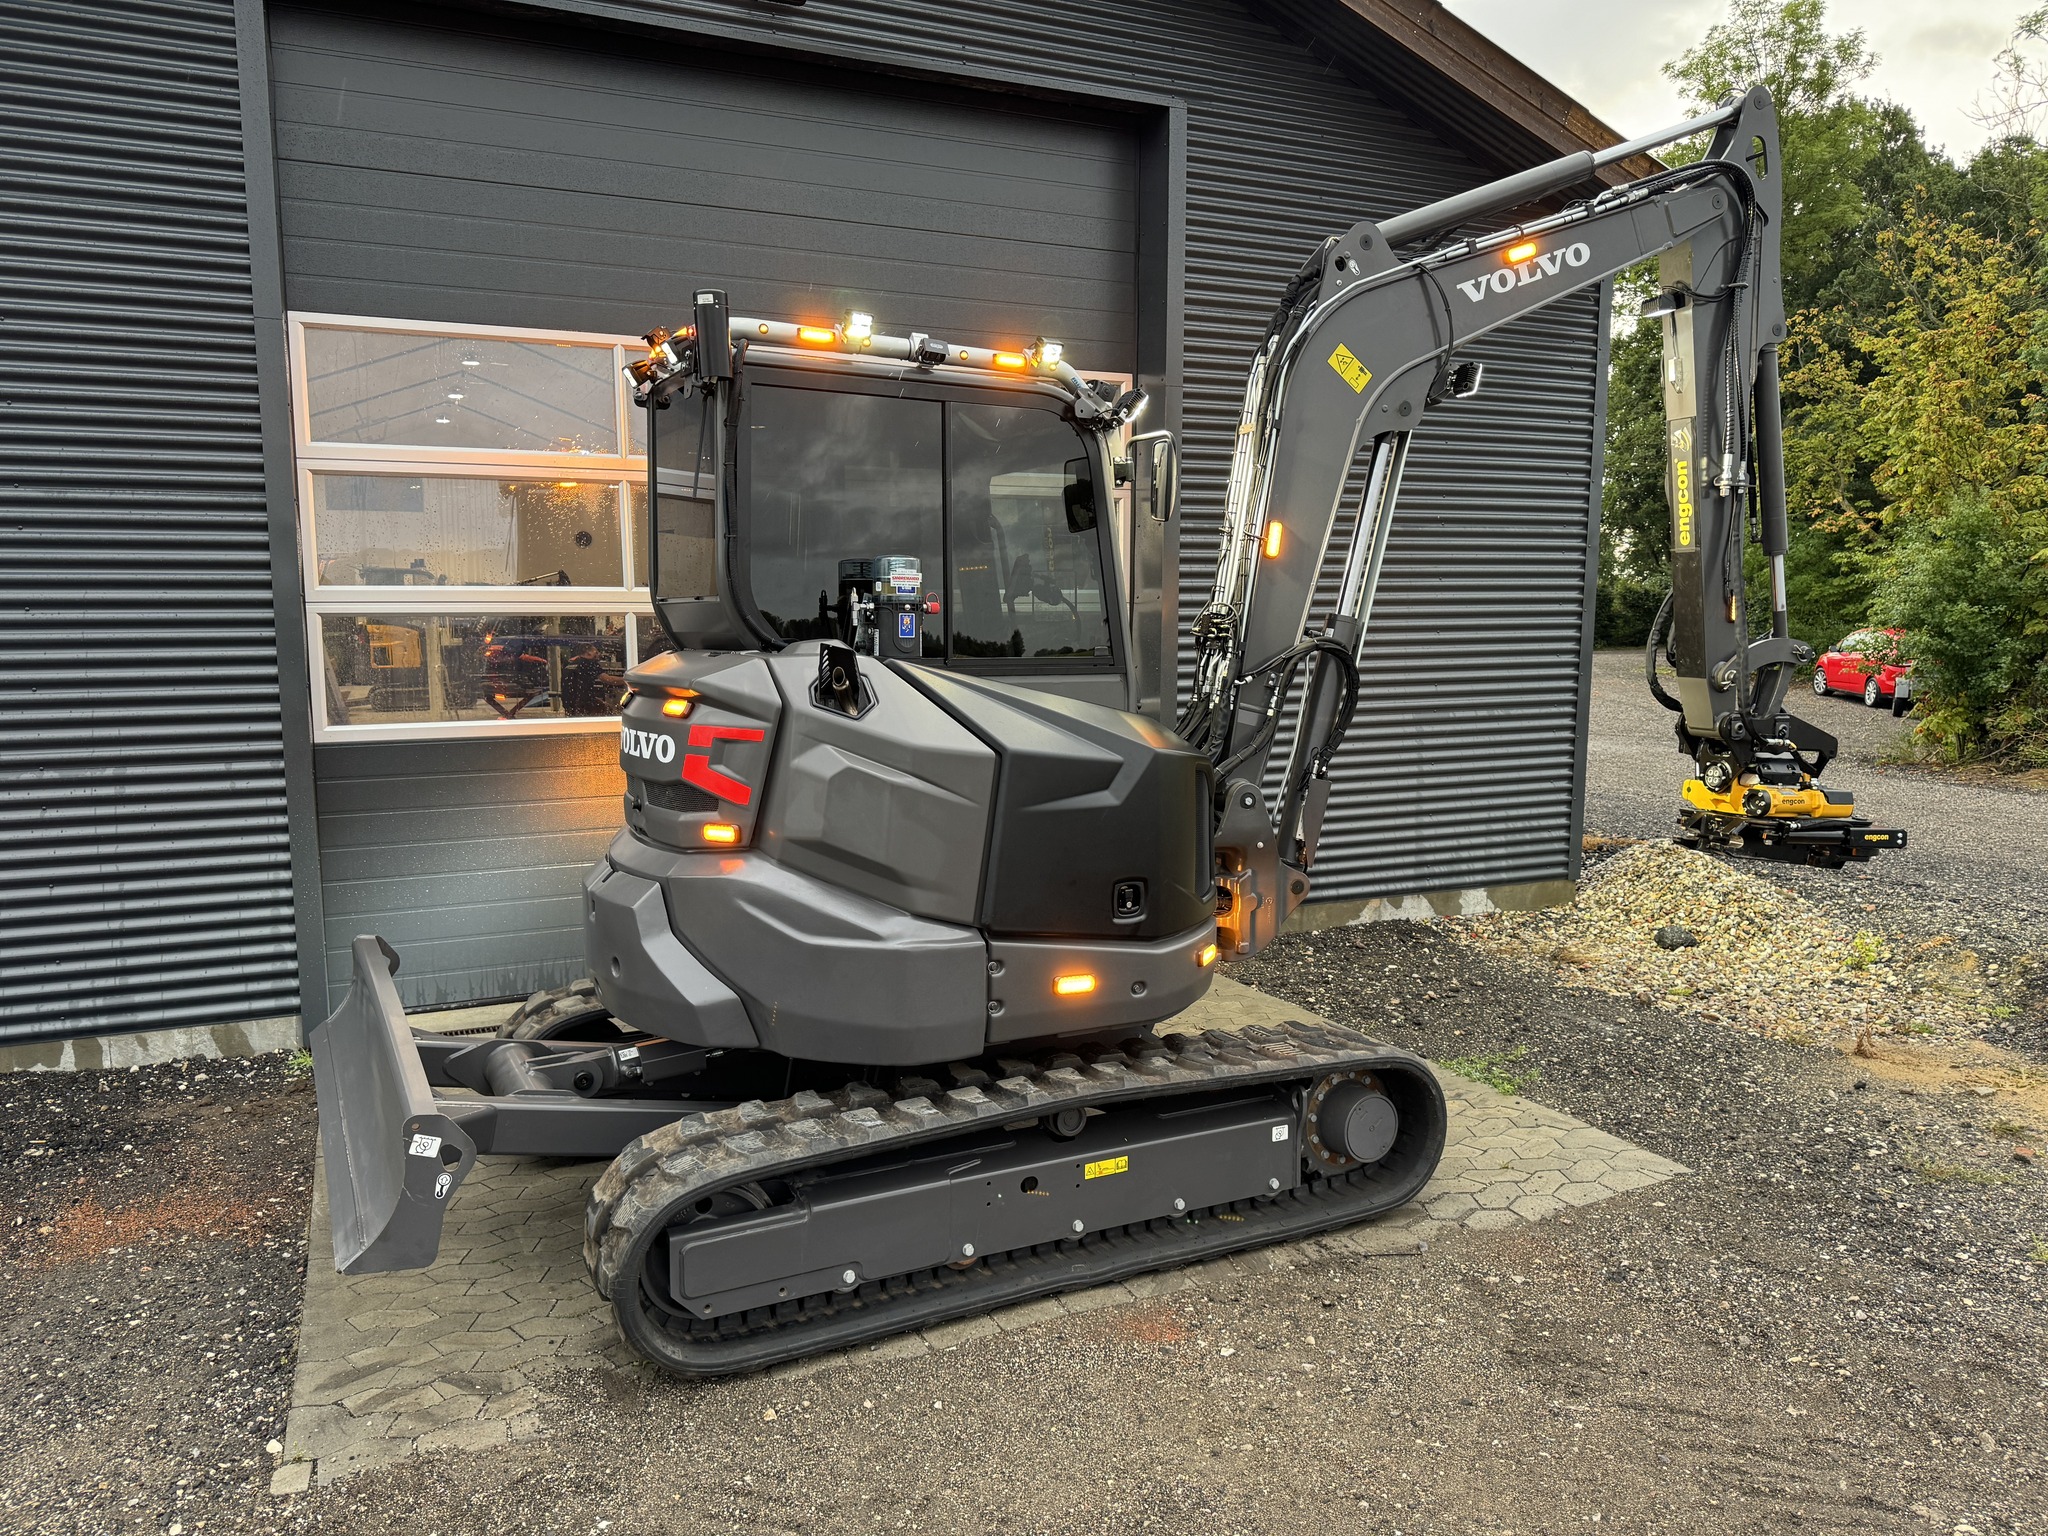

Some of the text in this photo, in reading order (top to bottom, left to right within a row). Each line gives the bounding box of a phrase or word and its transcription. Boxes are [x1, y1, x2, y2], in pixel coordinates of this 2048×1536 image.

[1456, 242, 1591, 302] VOLVO
[1676, 460, 1693, 546] engcon
[621, 726, 676, 764] OLVO
[1781, 798, 1806, 806] engcon
[1864, 834, 1890, 842] engcon
